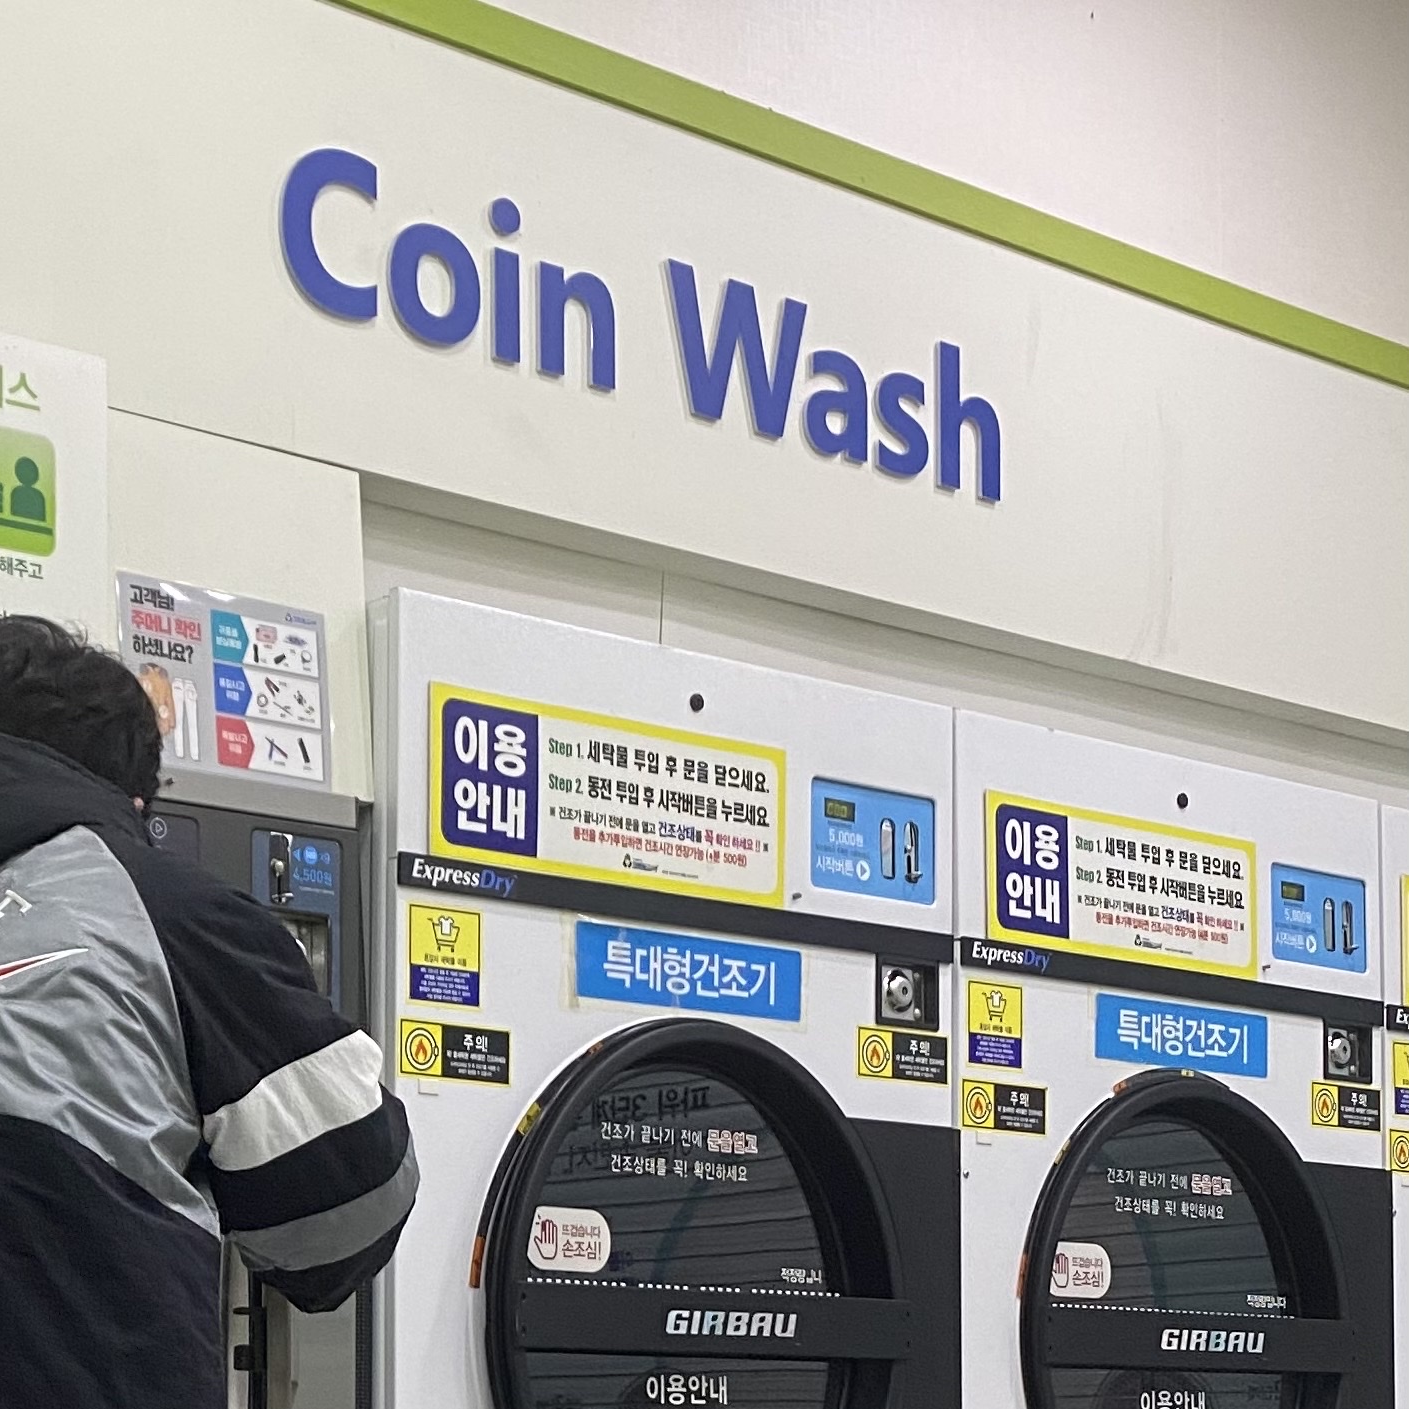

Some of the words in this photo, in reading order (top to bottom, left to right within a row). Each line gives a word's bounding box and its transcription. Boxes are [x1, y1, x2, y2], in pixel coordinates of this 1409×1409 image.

[279, 148, 616, 394] Coin
[660, 257, 1001, 503] Wash
[131, 609, 172, 636] 주머니
[174, 616, 201, 642] 확인
[132, 634, 194, 664] 하셨나요?
[454, 715, 526, 778] 이용
[548, 738, 572, 759] Step
[587, 739, 628, 769] 세탁물
[634, 750, 659, 775] 투입
[665, 755, 677, 777] 후
[683, 760, 708, 783] 문을
[715, 765, 770, 793] 닫으세요.
[454, 778, 526, 841] 안내
[548, 773, 573, 794] Step
[588, 775, 612, 801] 동전
[616, 782, 640, 806] 투입
[642, 787, 655, 807] 후
[658, 789, 718, 818] 시작버튼을
[1005, 818, 1059, 870] 이용
[412, 858, 516, 898] ExpressDry
[1005, 872, 1060, 924] 안내
[972, 942, 1051, 971] ExpressDry
[603, 940, 775, 1005] 특대형건조기
[1117, 1009, 1249, 1064] 특대형건조기
[601, 1121, 636, 1141] 건조가
[641, 1126, 675, 1146] 끝나기
[680, 1129, 703, 1148] 전에
[611, 1155, 667, 1176] 건조상태를
[693, 1160, 748, 1182] 확인하세요
[1107, 1168, 1134, 1185] 건조가
[1138, 1171, 1166, 1188] 끝나기
[1170, 1174, 1188, 1189] 전에
[1114, 1196, 1159, 1215] 건조상태를
[1181, 1201, 1224, 1220] 확인하세요
[562, 1224, 601, 1238] 뜨겁습니다
[562, 1240, 602, 1261] 손조심!
[1072, 1271, 1104, 1288] 손조심!
[665, 1309, 799, 1338] GIRBAU
[1160, 1329, 1265, 1353] GIRBAU
[646, 1375, 728, 1405] 이용안내
